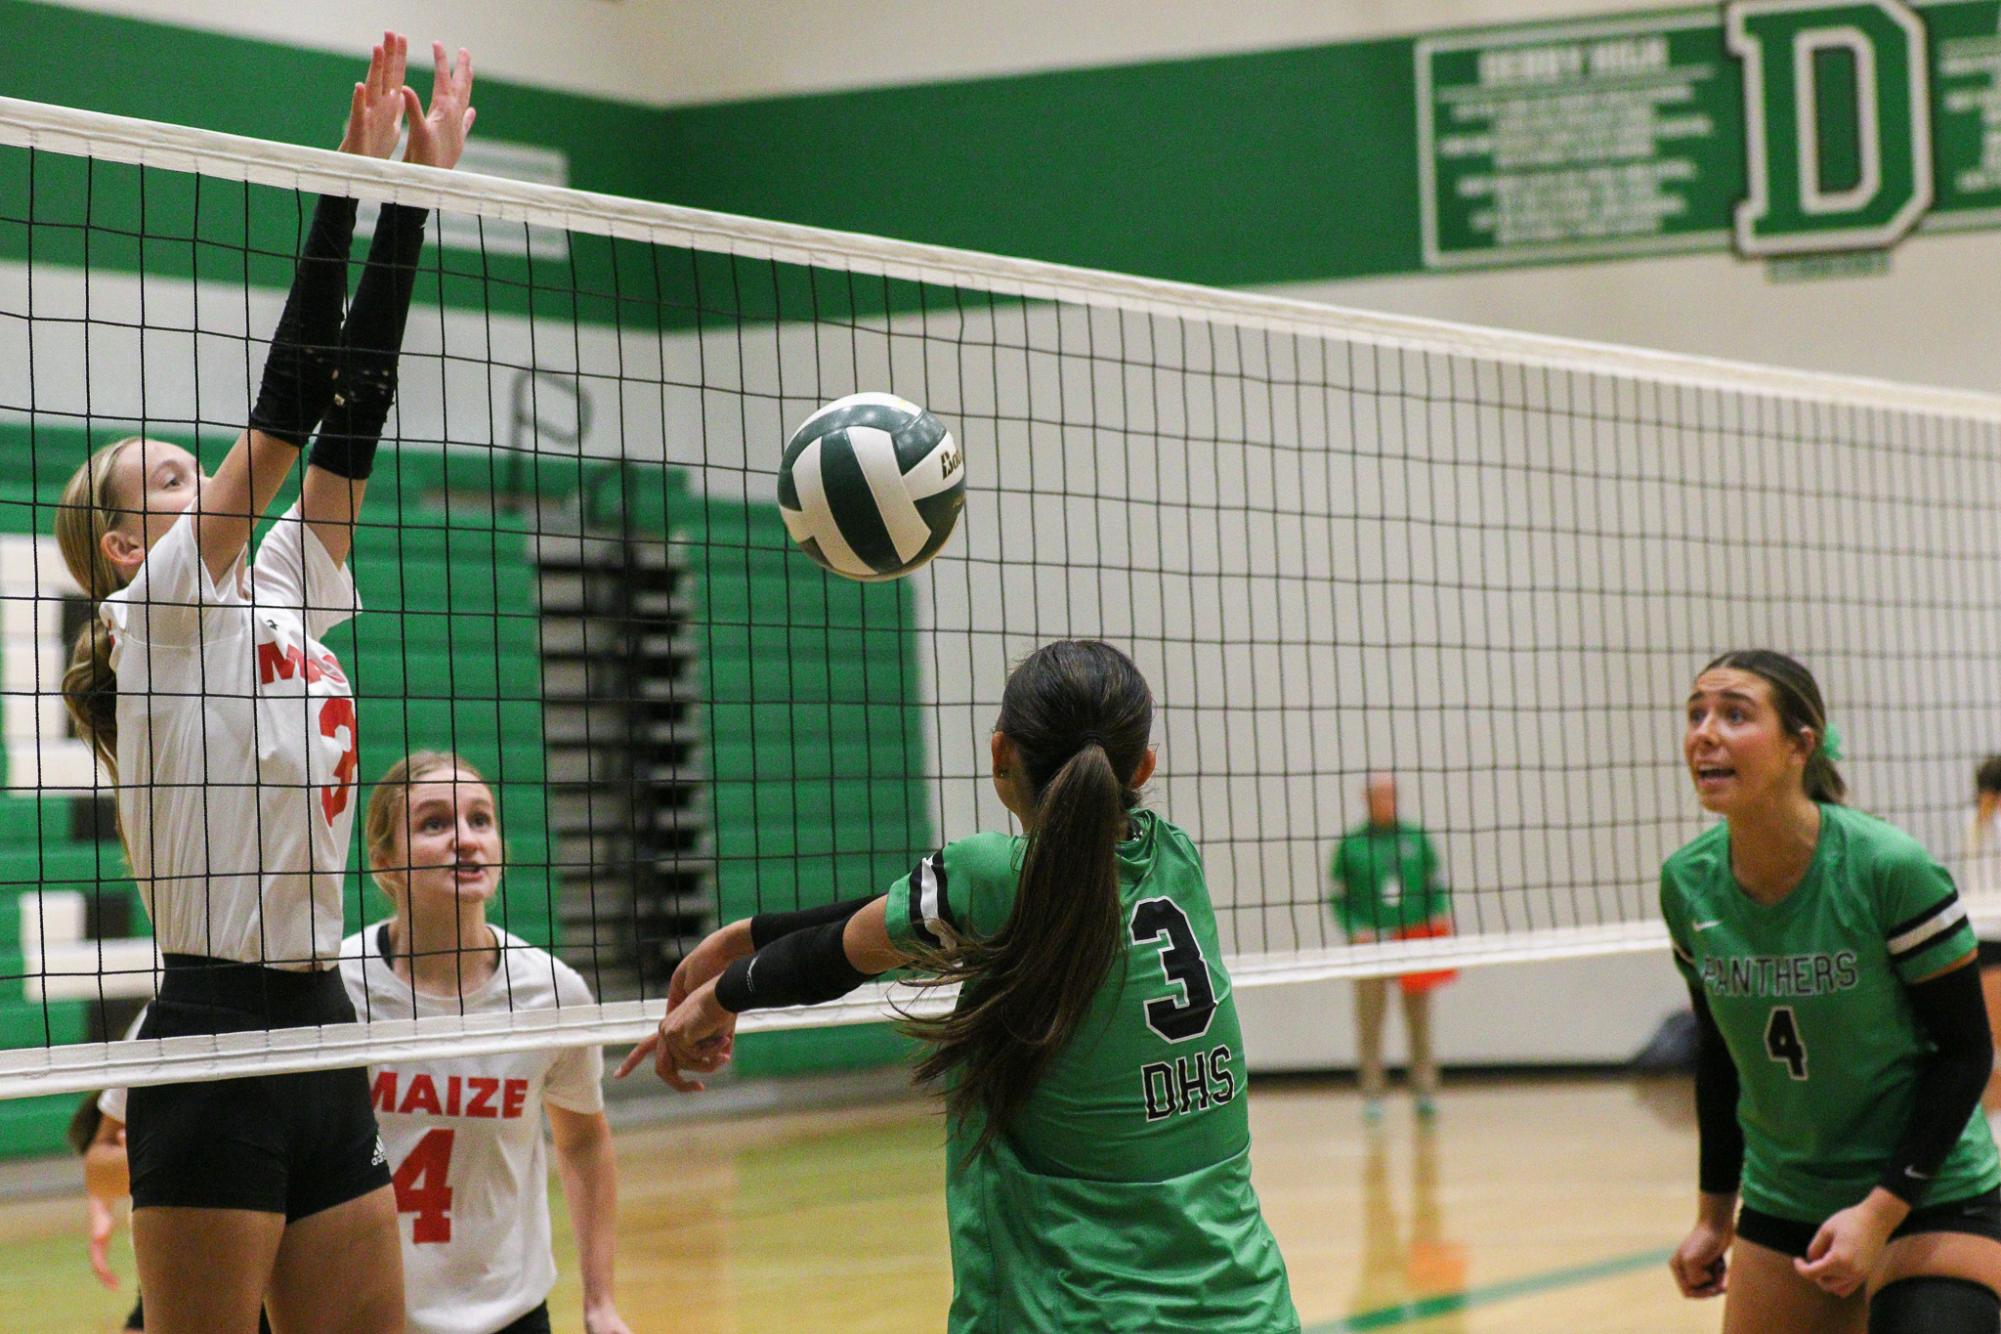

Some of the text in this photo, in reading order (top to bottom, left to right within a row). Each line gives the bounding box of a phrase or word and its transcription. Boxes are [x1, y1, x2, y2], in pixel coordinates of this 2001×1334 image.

[1728, 0, 1934, 253] D
[319, 697, 357, 828] 3
[1128, 895, 1219, 1045] 3
[1702, 950, 1858, 998] PANTHERS
[1141, 1044, 1234, 1122] DHS
[1764, 1005, 1809, 1081] 4
[392, 1128, 455, 1244] 4
